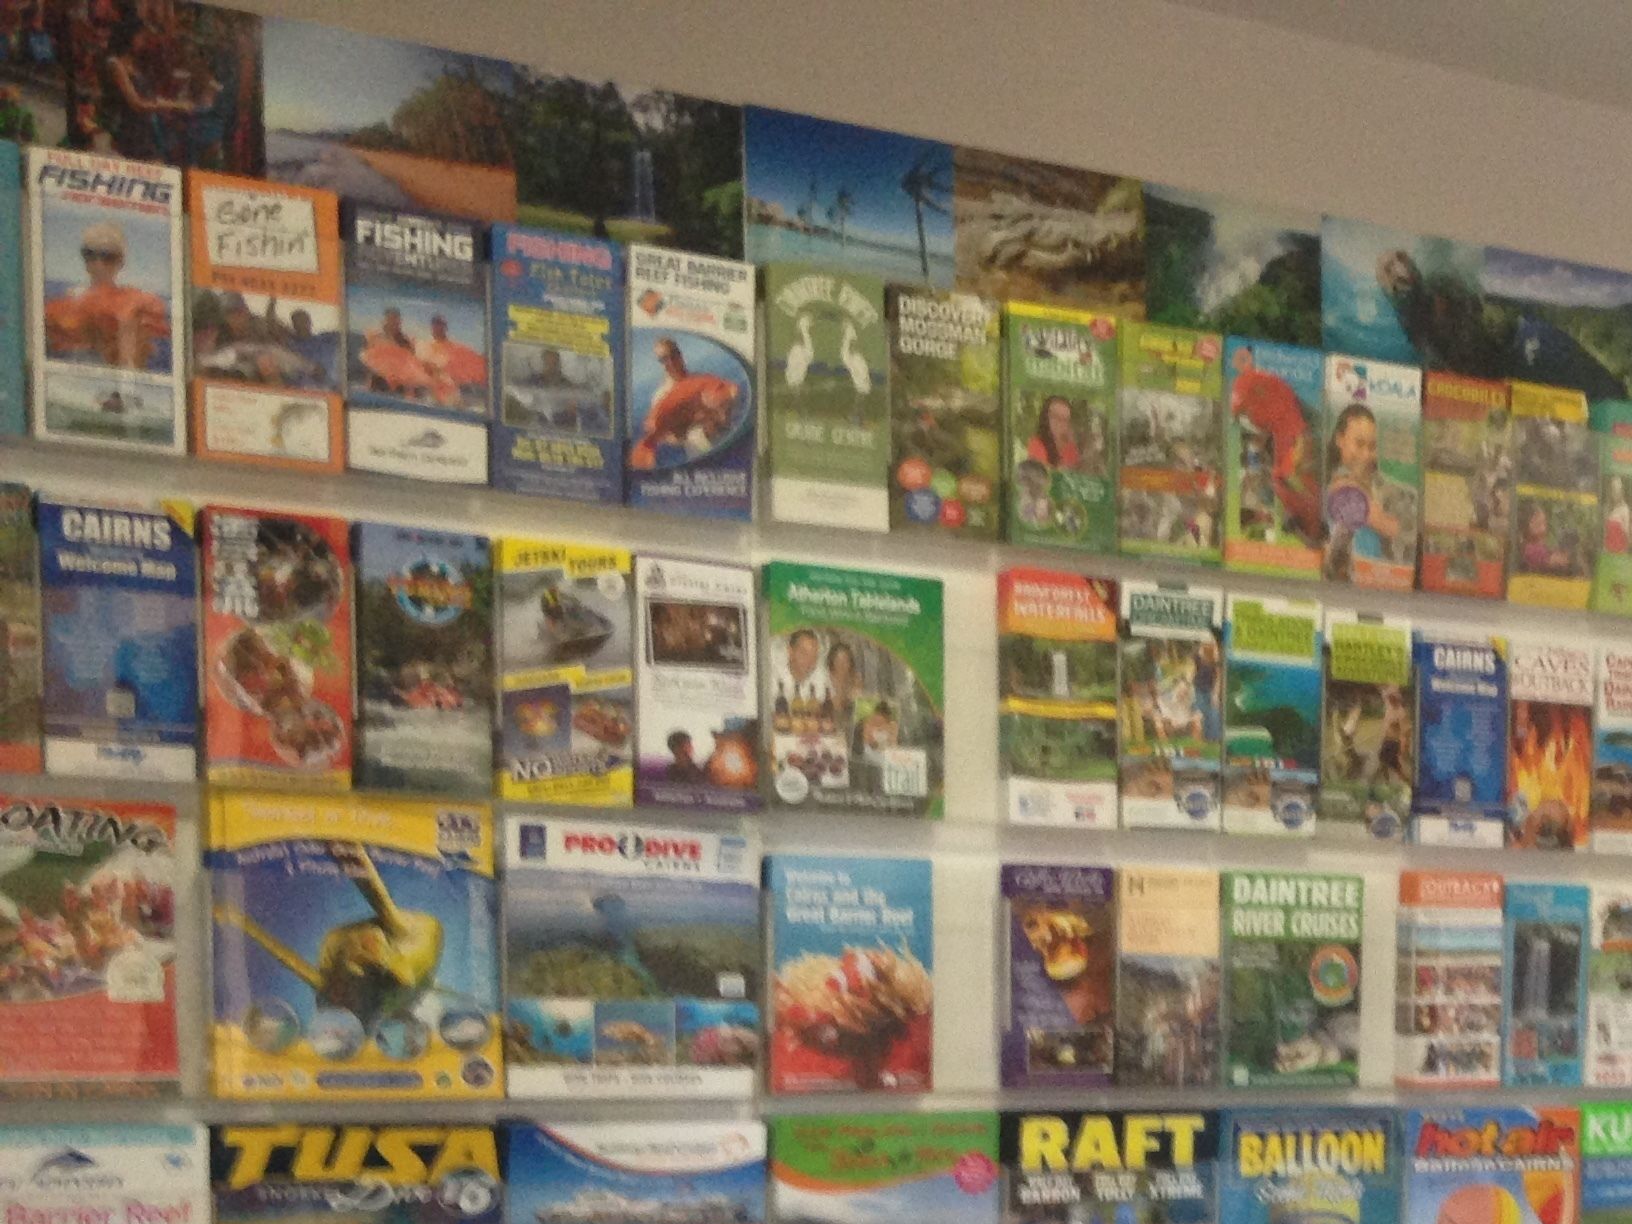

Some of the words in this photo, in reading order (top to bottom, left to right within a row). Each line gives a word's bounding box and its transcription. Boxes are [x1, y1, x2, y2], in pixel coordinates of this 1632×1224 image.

[38, 164, 174, 205] FISHING
[215, 200, 281, 226] Gone
[356, 218, 474, 262] FISHING
[635, 250, 681, 271] GREAT
[687, 259, 748, 281] BARRIER
[899, 316, 987, 346] MOSSMAN
[900, 337, 958, 361] GORGE
[62, 510, 171, 552] CAIRNS
[58, 551, 137, 578] Welcome
[1433, 646, 1495, 676] CAIRNS
[564, 833, 618, 856] PRO
[643, 837, 702, 865] DIVE
[1233, 876, 1359, 909] DAINTREE
[1232, 909, 1285, 935] RIVER
[1290, 911, 1360, 939] CRUISES
[226, 1127, 502, 1188] TUSA
[1020, 1113, 1205, 1171] RAFT
[1240, 1129, 1386, 1179] BALLOON
